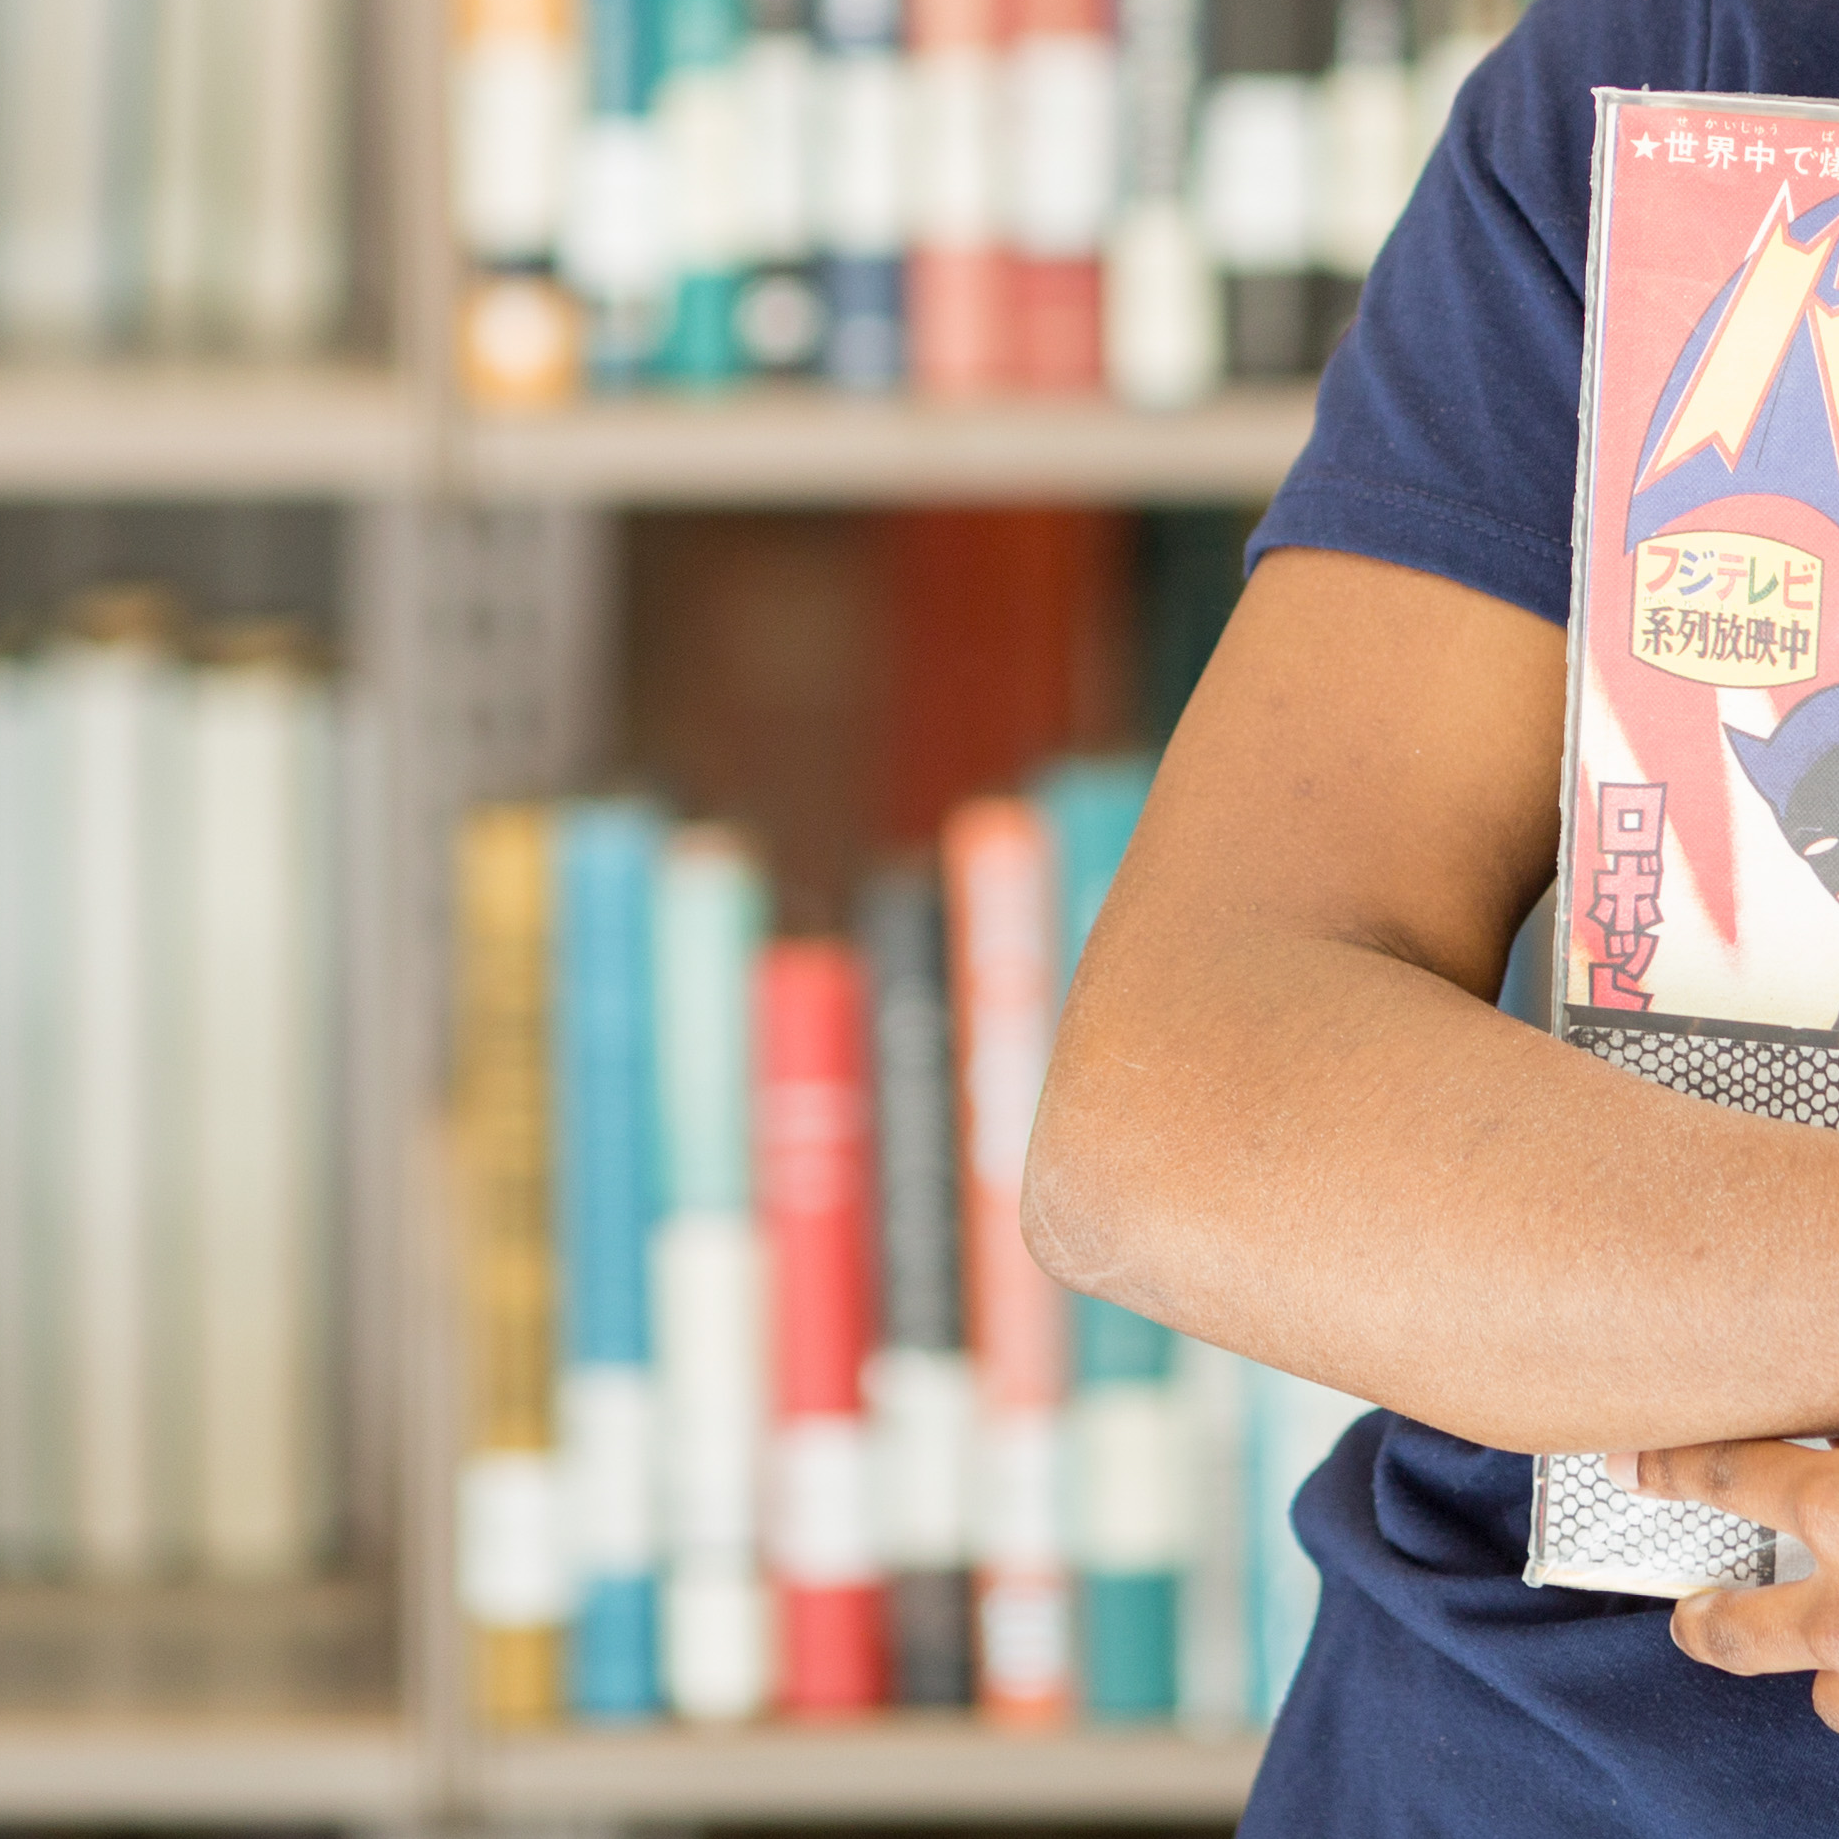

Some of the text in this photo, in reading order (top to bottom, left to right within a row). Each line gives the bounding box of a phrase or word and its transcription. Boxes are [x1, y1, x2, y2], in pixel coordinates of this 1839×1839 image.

[1645, 544, 1817, 611] フジテレビ
[1641, 606, 1811, 671] 系列放映中
[1586, 781, 1668, 1012] ロボット
